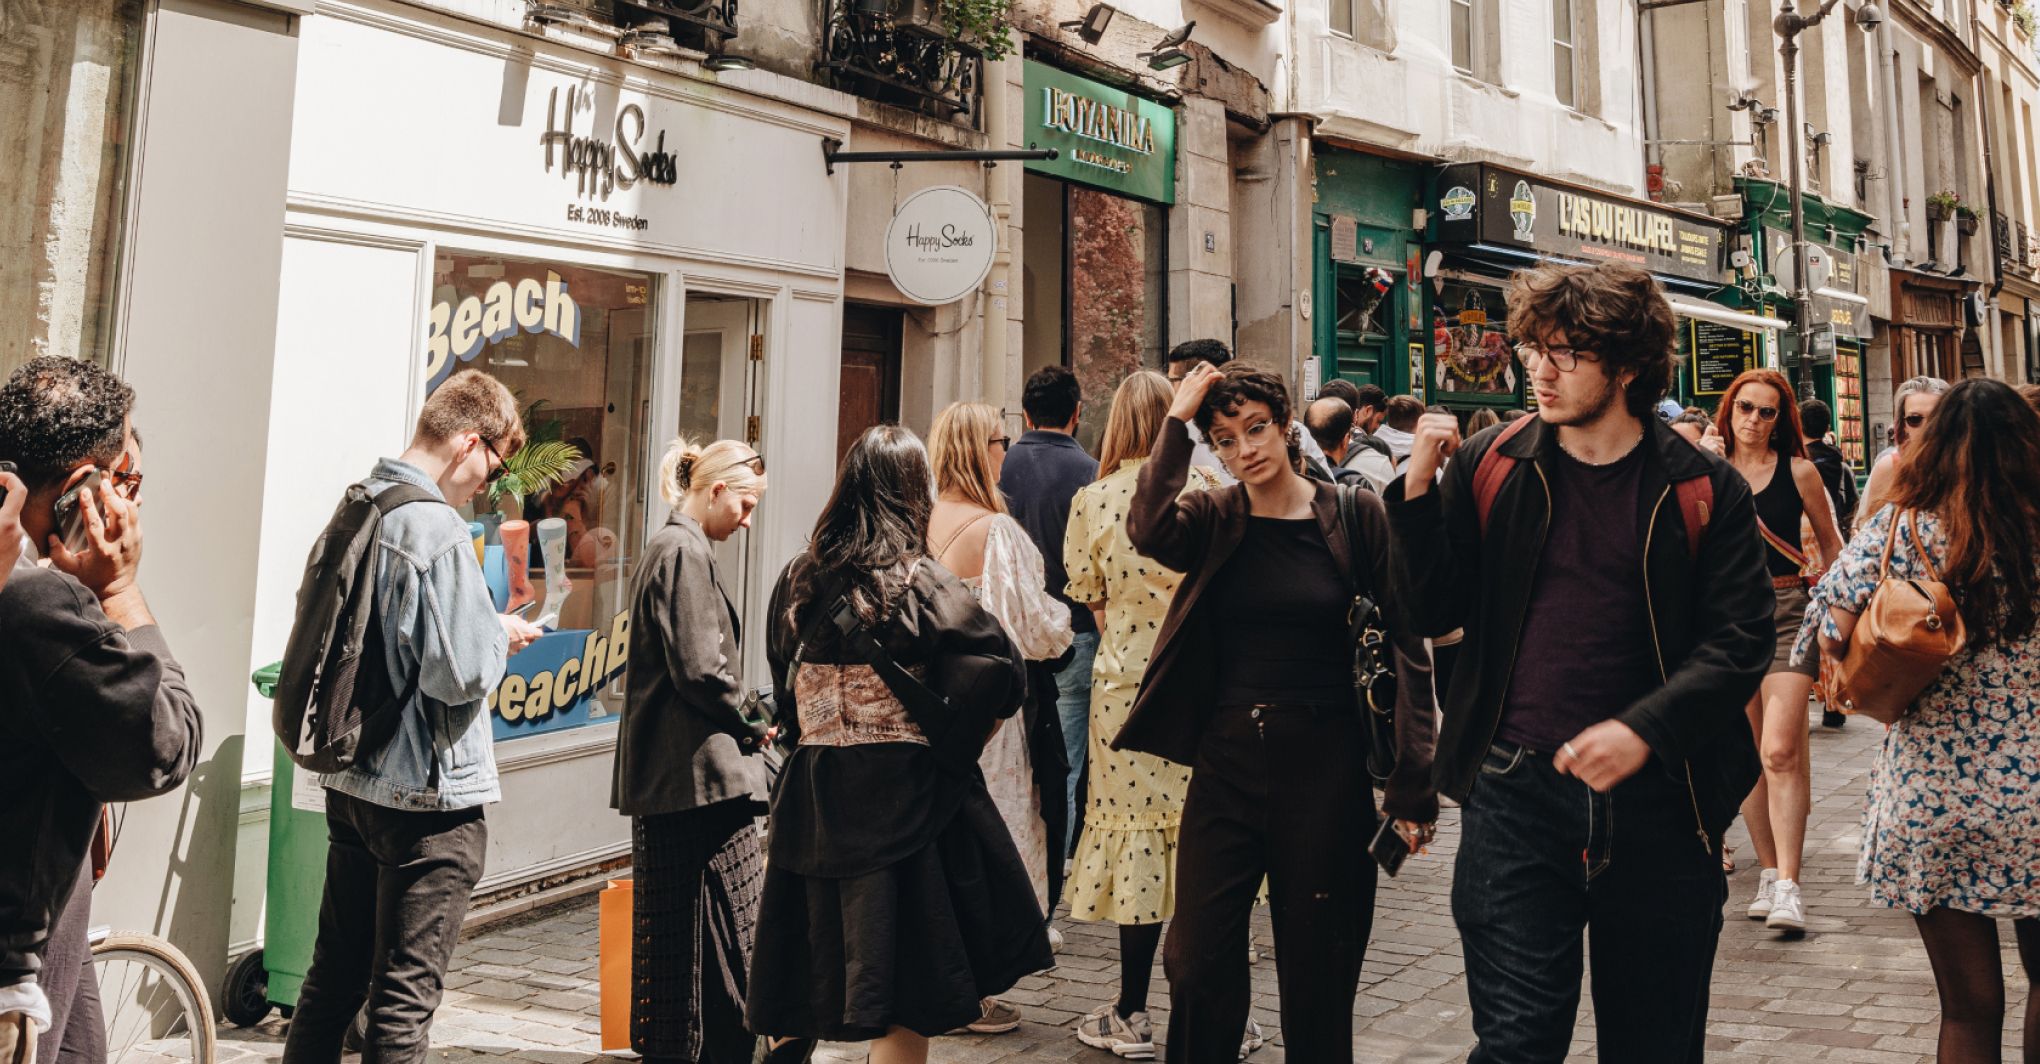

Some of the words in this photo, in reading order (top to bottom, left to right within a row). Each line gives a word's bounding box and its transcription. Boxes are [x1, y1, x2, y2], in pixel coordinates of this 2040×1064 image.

[541, 84, 615, 201] Happy
[615, 103, 678, 191] Socks
[612, 211, 649, 231] Sweden
[906, 222, 941, 253] Happy
[941, 223, 974, 249] Socks
[1591, 198, 1614, 241] DU
[1615, 207, 1677, 252] FALLAFEL
[426, 269, 582, 388] Beach
